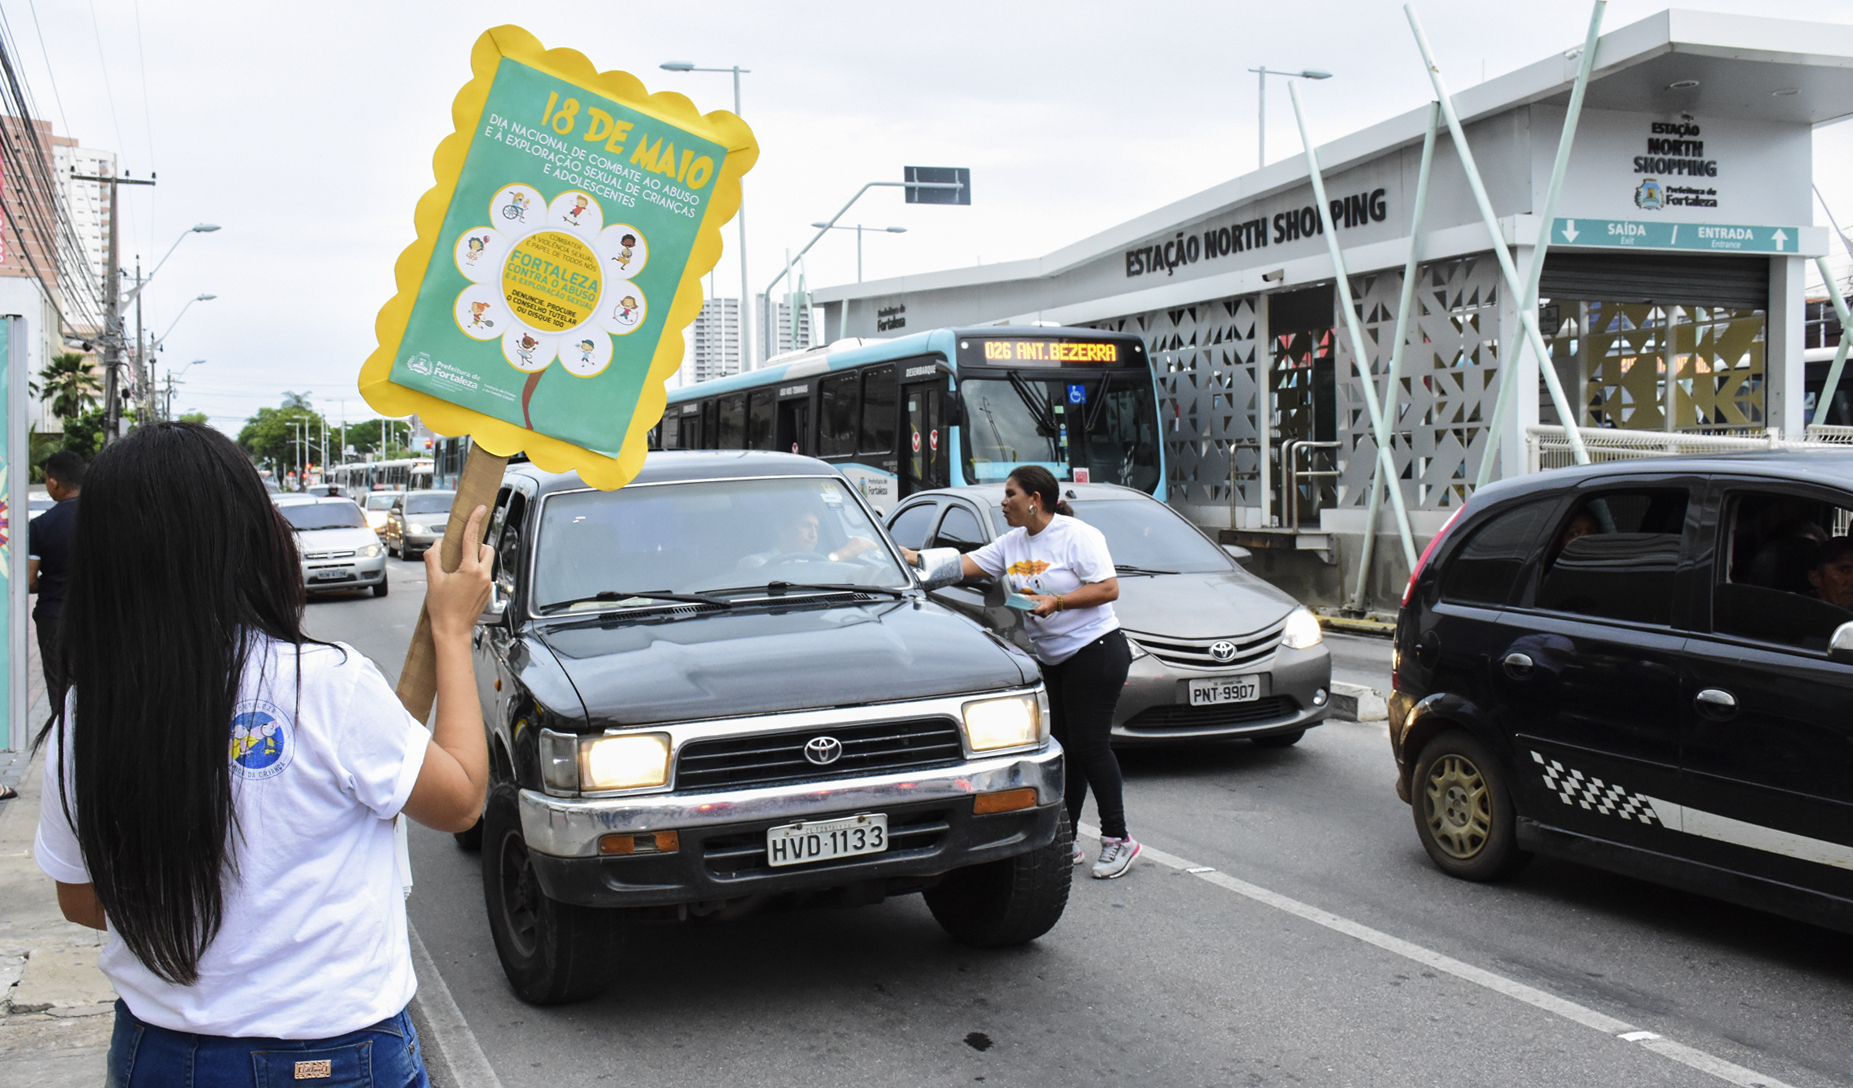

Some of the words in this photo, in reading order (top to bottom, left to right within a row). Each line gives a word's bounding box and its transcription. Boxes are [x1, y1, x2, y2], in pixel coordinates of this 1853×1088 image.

[541, 91, 580, 135] 18
[583, 106, 634, 155] DE
[629, 133, 714, 190] MAIO
[1651, 122, 1700, 138] ESTAÇÃO
[1648, 138, 1704, 158] NORTH
[489, 113, 508, 130] DIA
[511, 122, 568, 154] NACIONAL
[571, 146, 587, 160] DE
[588, 154, 642, 183] COMBATE
[642, 176, 661, 190] AO
[662, 184, 700, 206] ABUSO
[1634, 156, 1718, 177] SHOPPING
[484, 126, 494, 137] E
[494, 128, 502, 141] À
[505, 134, 582, 172] EXPLORAÇÃO
[584, 166, 622, 190] SEXUAL
[625, 182, 641, 196] DE
[642, 190, 696, 218] CRIANÇAS
[543, 163, 552, 174] E
[552, 168, 636, 208] ADOLESCENTES
[1666, 186, 1705, 196] Prefeitura
[1706, 188, 1717, 196] de
[1666, 194, 1718, 208] Fortaleza
[549, 234, 582, 250] COMBATER
[1608, 222, 1646, 236] SAÍDA
[1698, 226, 1754, 240] ENTRADA
[538, 236, 570, 254] VIOLÊNCIA
[571, 249, 594, 263] SEXUAL
[1126, 232, 1200, 278] ESTAÇÃO
[1204, 217, 1268, 260] NORTH
[1620, 236, 1634, 246] Exit
[1711, 240, 1742, 250] Entrance
[531, 241, 551, 254] PAPEL
[552, 250, 560, 258] DE
[562, 254, 583, 267] TODOS
[584, 262, 597, 272] NÓS
[507, 262, 548, 284] CONTRA
[551, 279, 559, 288] O
[561, 283, 596, 302] ABUSO
[510, 250, 598, 293] FORTALEZA
[518, 277, 565, 299] EXPLORAÇÃO
[566, 295, 593, 310] SEXUAL
[513, 297, 547, 314] CONSELHO
[548, 310, 578, 325] TUTELAR
[516, 306, 526, 314] OU
[527, 309, 551, 324] DISQUE
[552, 319, 564, 328] 100
[547, 302, 577, 318] PROCURE
[984, 341, 1012, 360] 026
[1016, 342, 1117, 362] ANT.BEZERRA
[434, 367, 478, 389] Fortaleza
[436, 360, 471, 378] Prefeitura
[868, 486, 888, 495] Fortaleza
